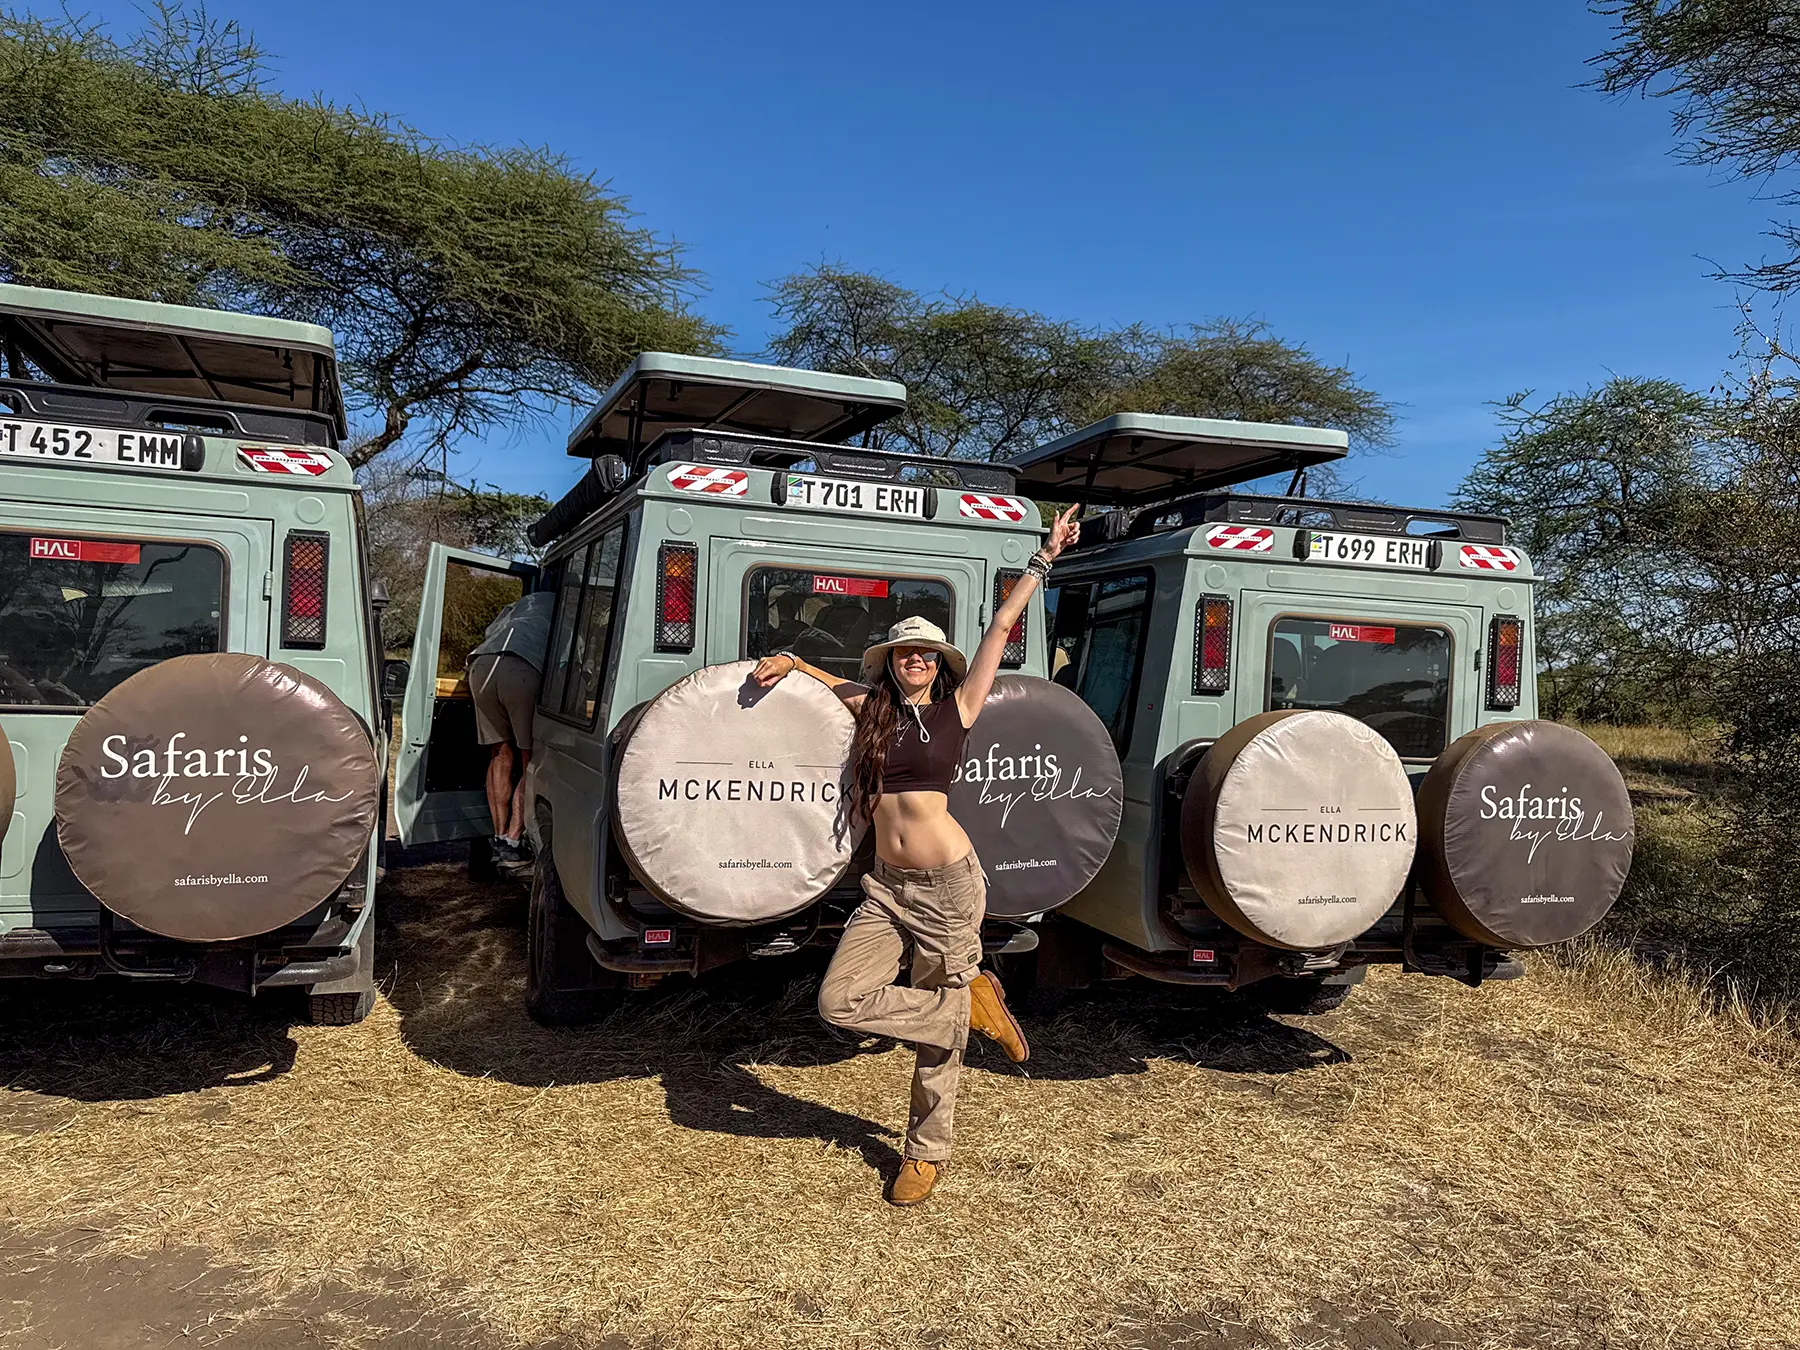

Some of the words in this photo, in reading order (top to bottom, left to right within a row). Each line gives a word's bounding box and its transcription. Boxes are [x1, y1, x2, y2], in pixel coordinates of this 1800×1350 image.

[4, 424, 22, 452] T
[29, 426, 93, 459] 452
[117, 434, 178, 466] EMM
[803, 480, 816, 504] T
[820, 481, 863, 509] 701
[875, 487, 918, 514] ERH
[34, 541, 76, 557] HAL
[1322, 535, 1334, 558] T
[1337, 537, 1376, 561] 699
[1385, 540, 1423, 565] ERH
[816, 578, 844, 592] HAL
[1331, 626, 1357, 639] HAL
[100, 732, 273, 779] Safaris
[748, 760, 775, 769] ELLA
[658, 778, 854, 803] MCKENDRICK
[978, 779, 1027, 829] by
[1030, 766, 1112, 802] Ella
[151, 773, 224, 836] by
[231, 765, 355, 806] Ella
[1320, 805, 1342, 814] ELLA
[1479, 783, 1582, 820] Safaris
[1247, 823, 1407, 844] MCKENDRICK
[1509, 816, 1552, 864] by
[1555, 810, 1628, 842] Ella
[718, 859, 793, 871] safarisbyella.com
[995, 859, 1057, 871] safarisbyella.com
[173, 872, 269, 887] safarisbyella.com
[1297, 894, 1357, 906] safarisbyella.com
[1520, 894, 1575, 905] safarisbyella.com
